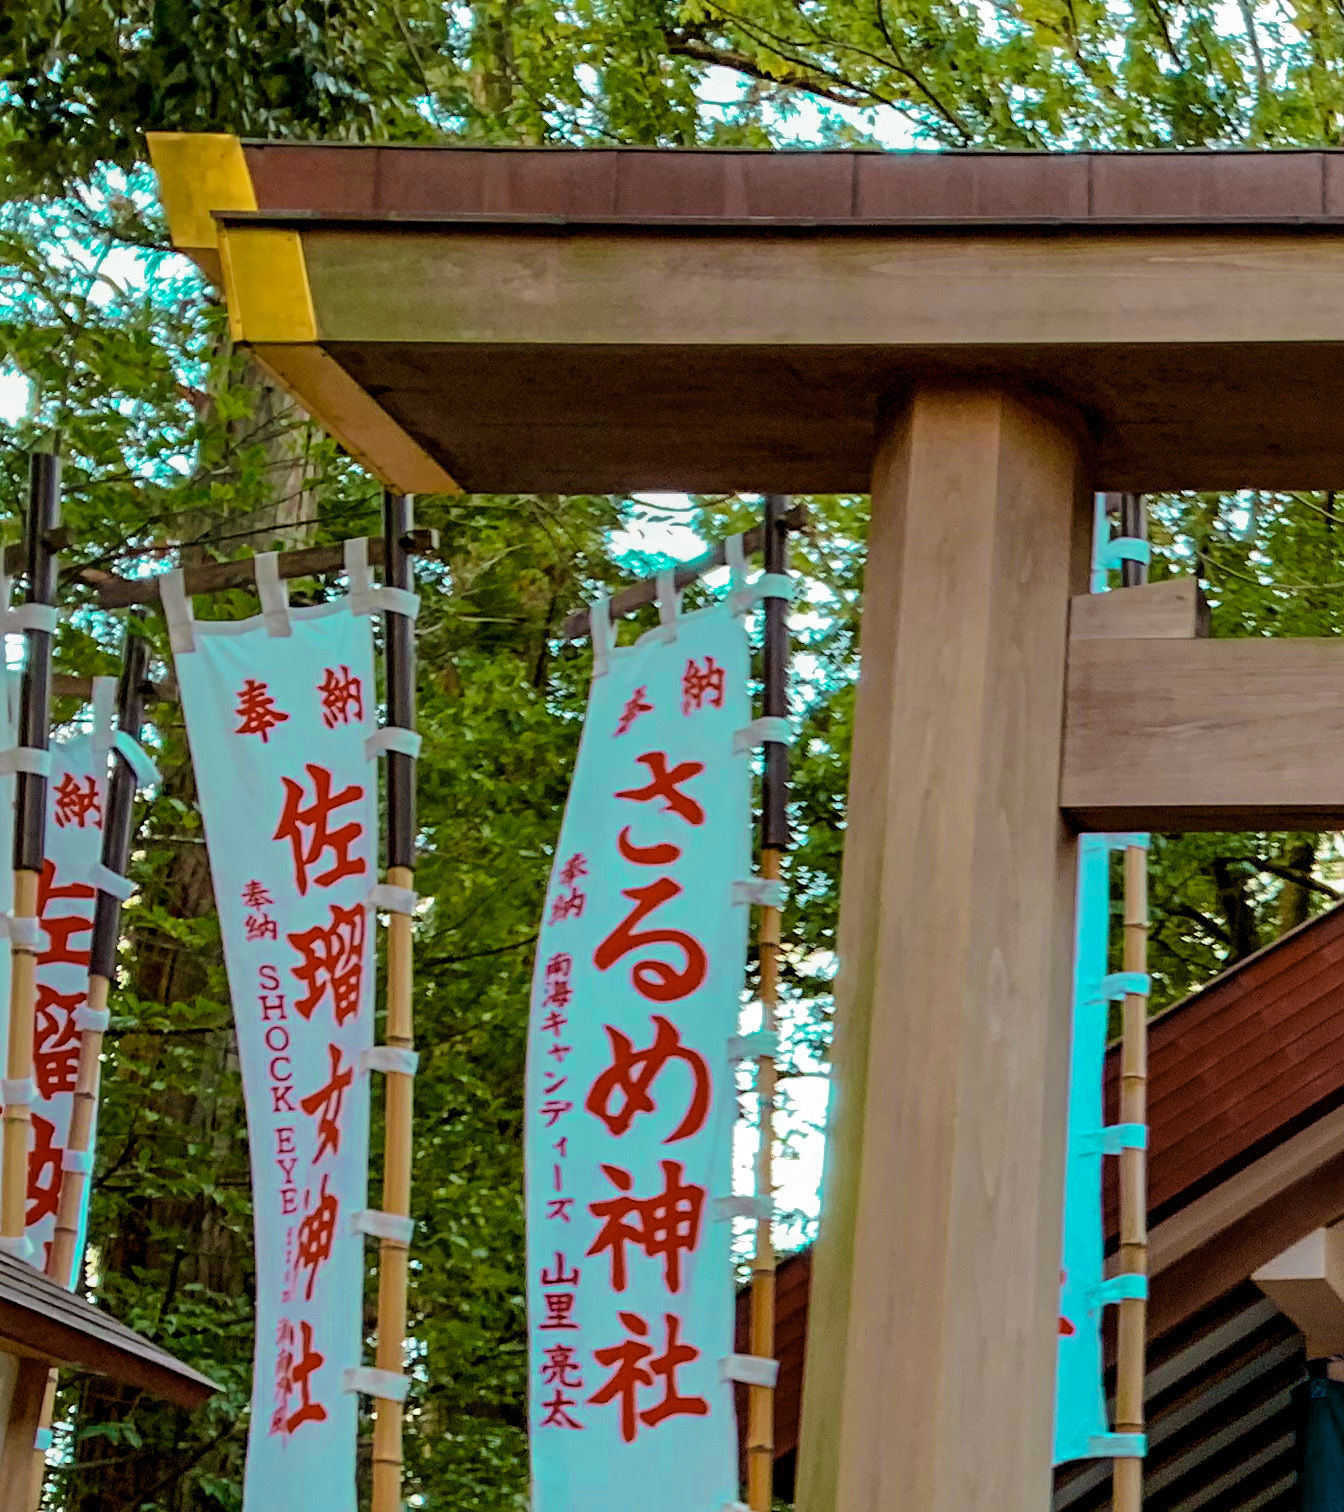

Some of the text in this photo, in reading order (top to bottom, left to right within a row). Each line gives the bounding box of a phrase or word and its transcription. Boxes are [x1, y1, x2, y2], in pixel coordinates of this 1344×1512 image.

[232, 663, 365, 744] 奉納
[53, 773, 103, 829] 納
[241, 879, 279, 942] 奉納
[259, 963, 296, 1114] SHOCK
[583, 750, 712, 1443] さるめ神社
[274, 1127, 299, 1216] EYE
[538, 1251, 585, 1430] 山里亮太
